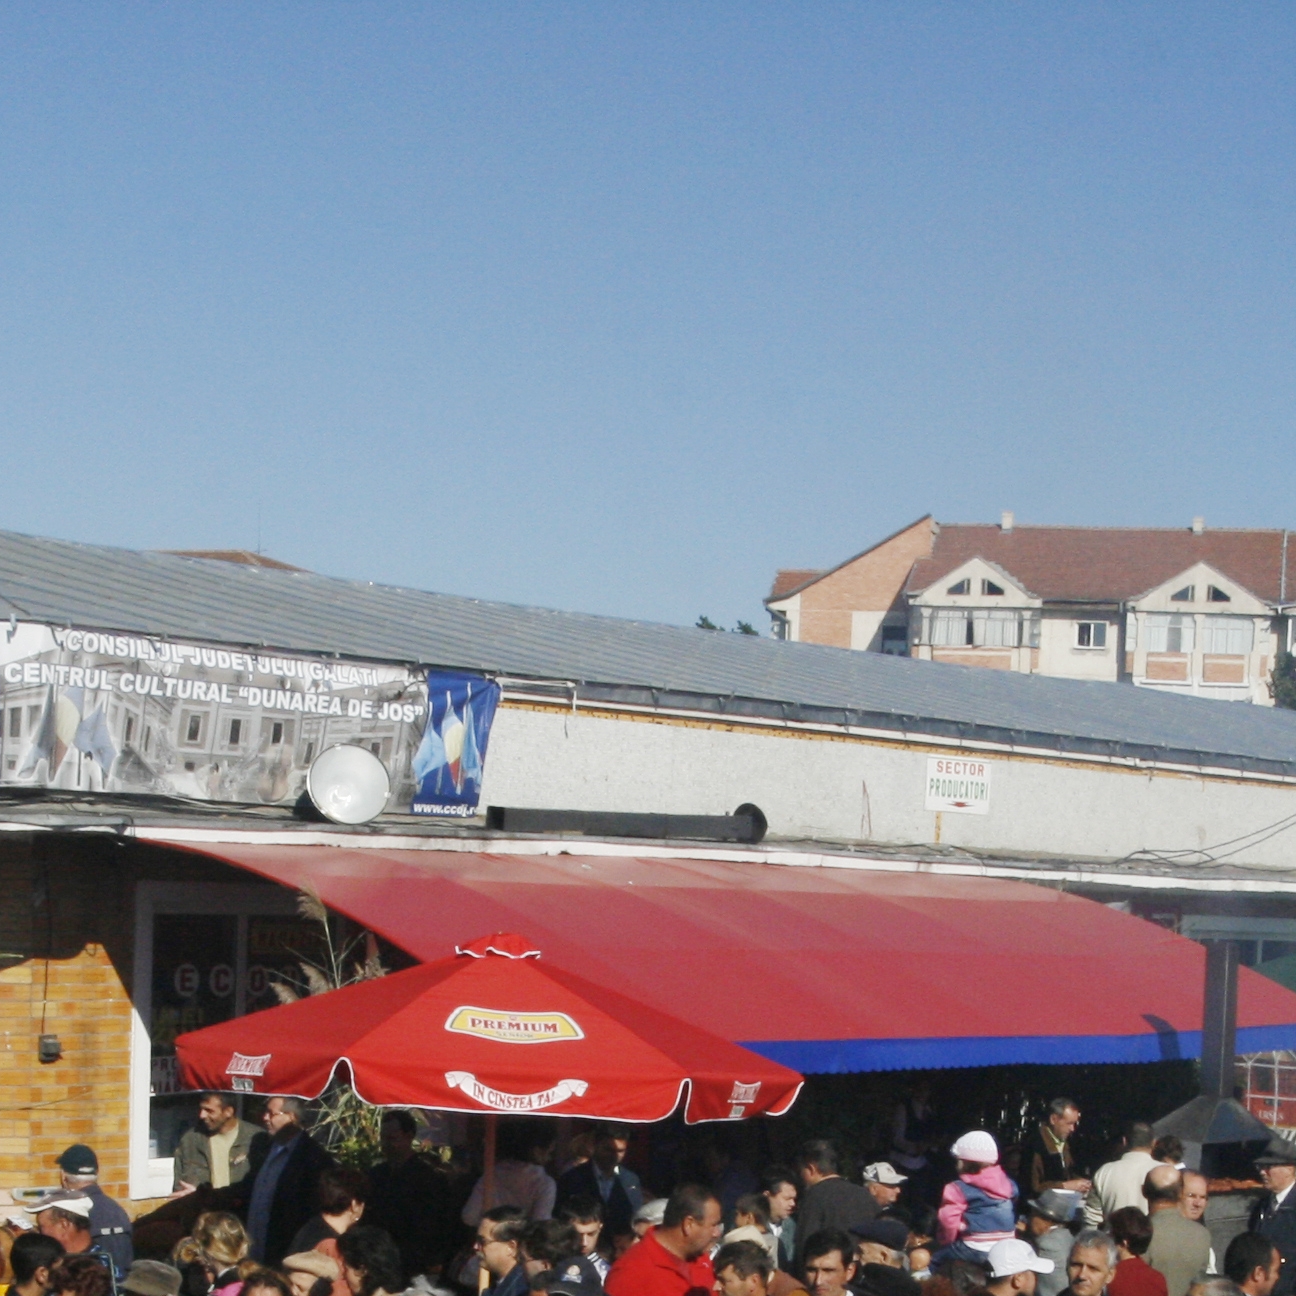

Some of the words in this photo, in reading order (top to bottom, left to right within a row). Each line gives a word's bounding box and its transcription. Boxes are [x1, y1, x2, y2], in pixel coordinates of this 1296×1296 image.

[4, 662, 113, 690] CENTRUL
[119, 672, 232, 704] CULTURAL
[348, 699, 373, 718] DE
[936, 760, 985, 777] SECTOR
[929, 778, 989, 801] PRODUCATORI
[470, 1018, 558, 1033] PREMIUM
[473, 1082, 485, 1100] IN
[487, 1090, 533, 1108] CINSTEA
